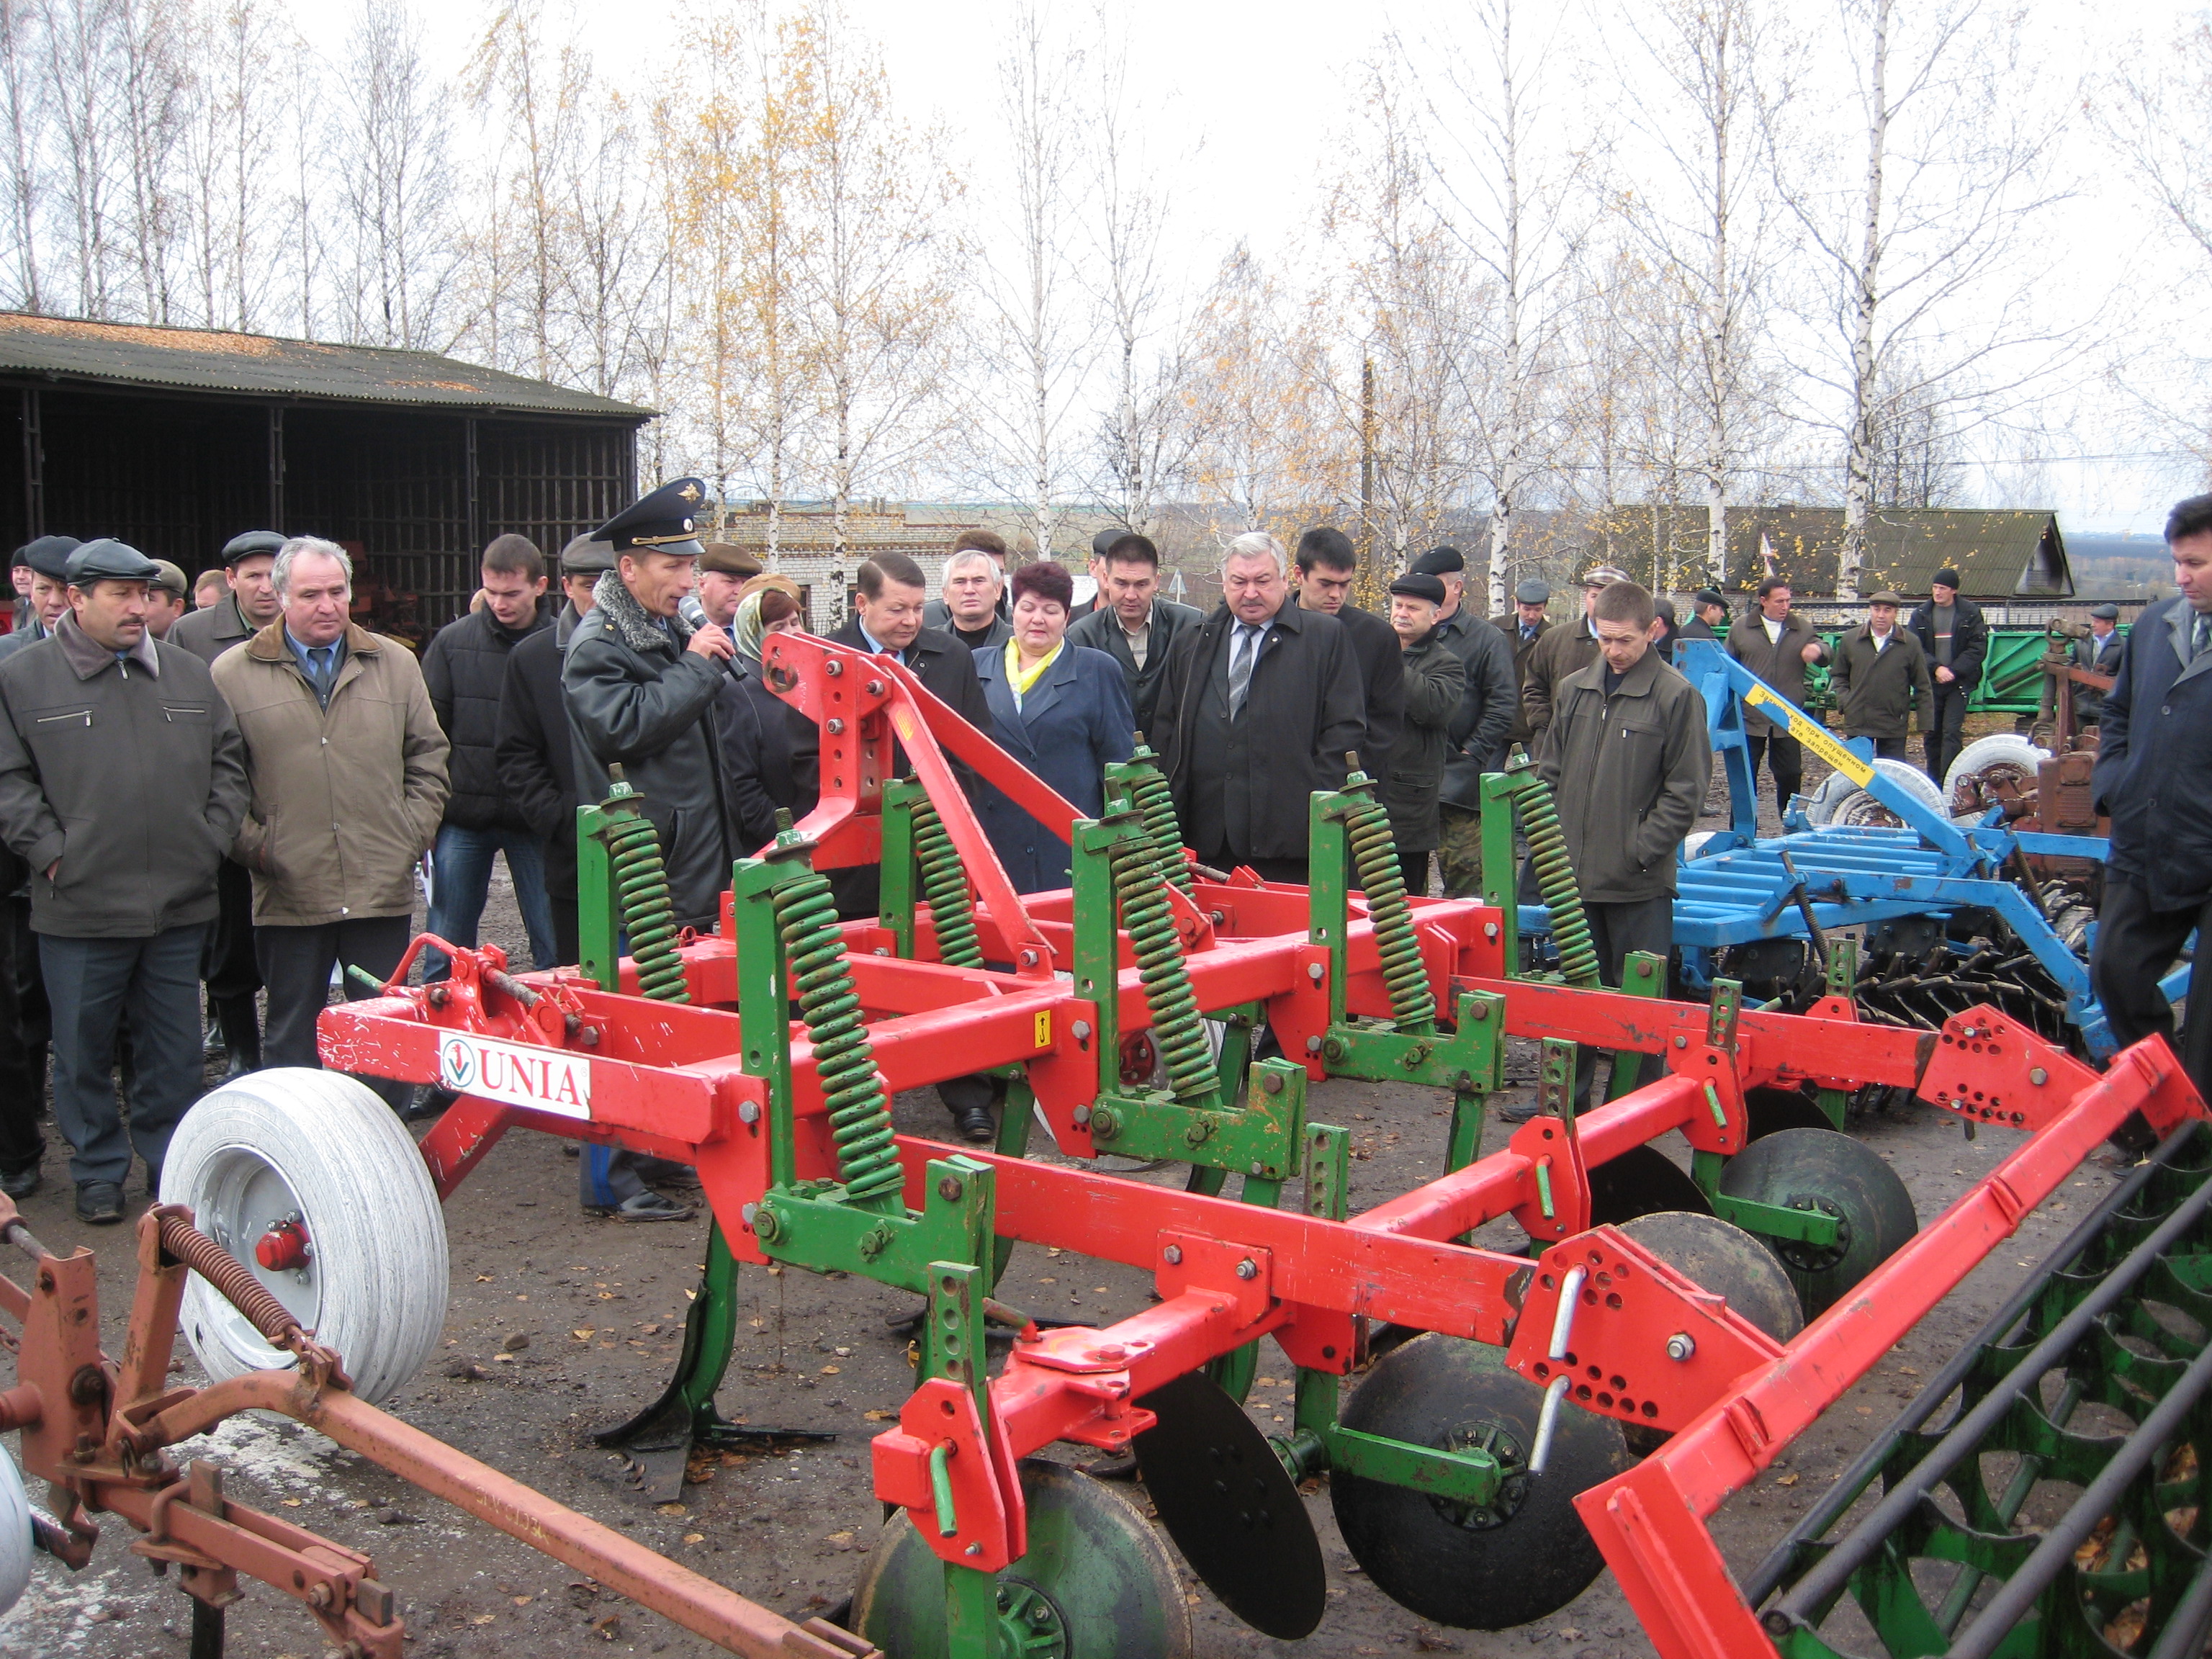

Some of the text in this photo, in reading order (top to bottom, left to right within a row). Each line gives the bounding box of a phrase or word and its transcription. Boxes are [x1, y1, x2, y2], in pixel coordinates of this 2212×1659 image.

[1789, 714, 1803, 727] ход
[1805, 727, 1820, 739] при
[1822, 739, 1866, 773] опущенном
[1806, 738, 1843, 767] запрещен
[477, 1048, 583, 1106] UNIA
